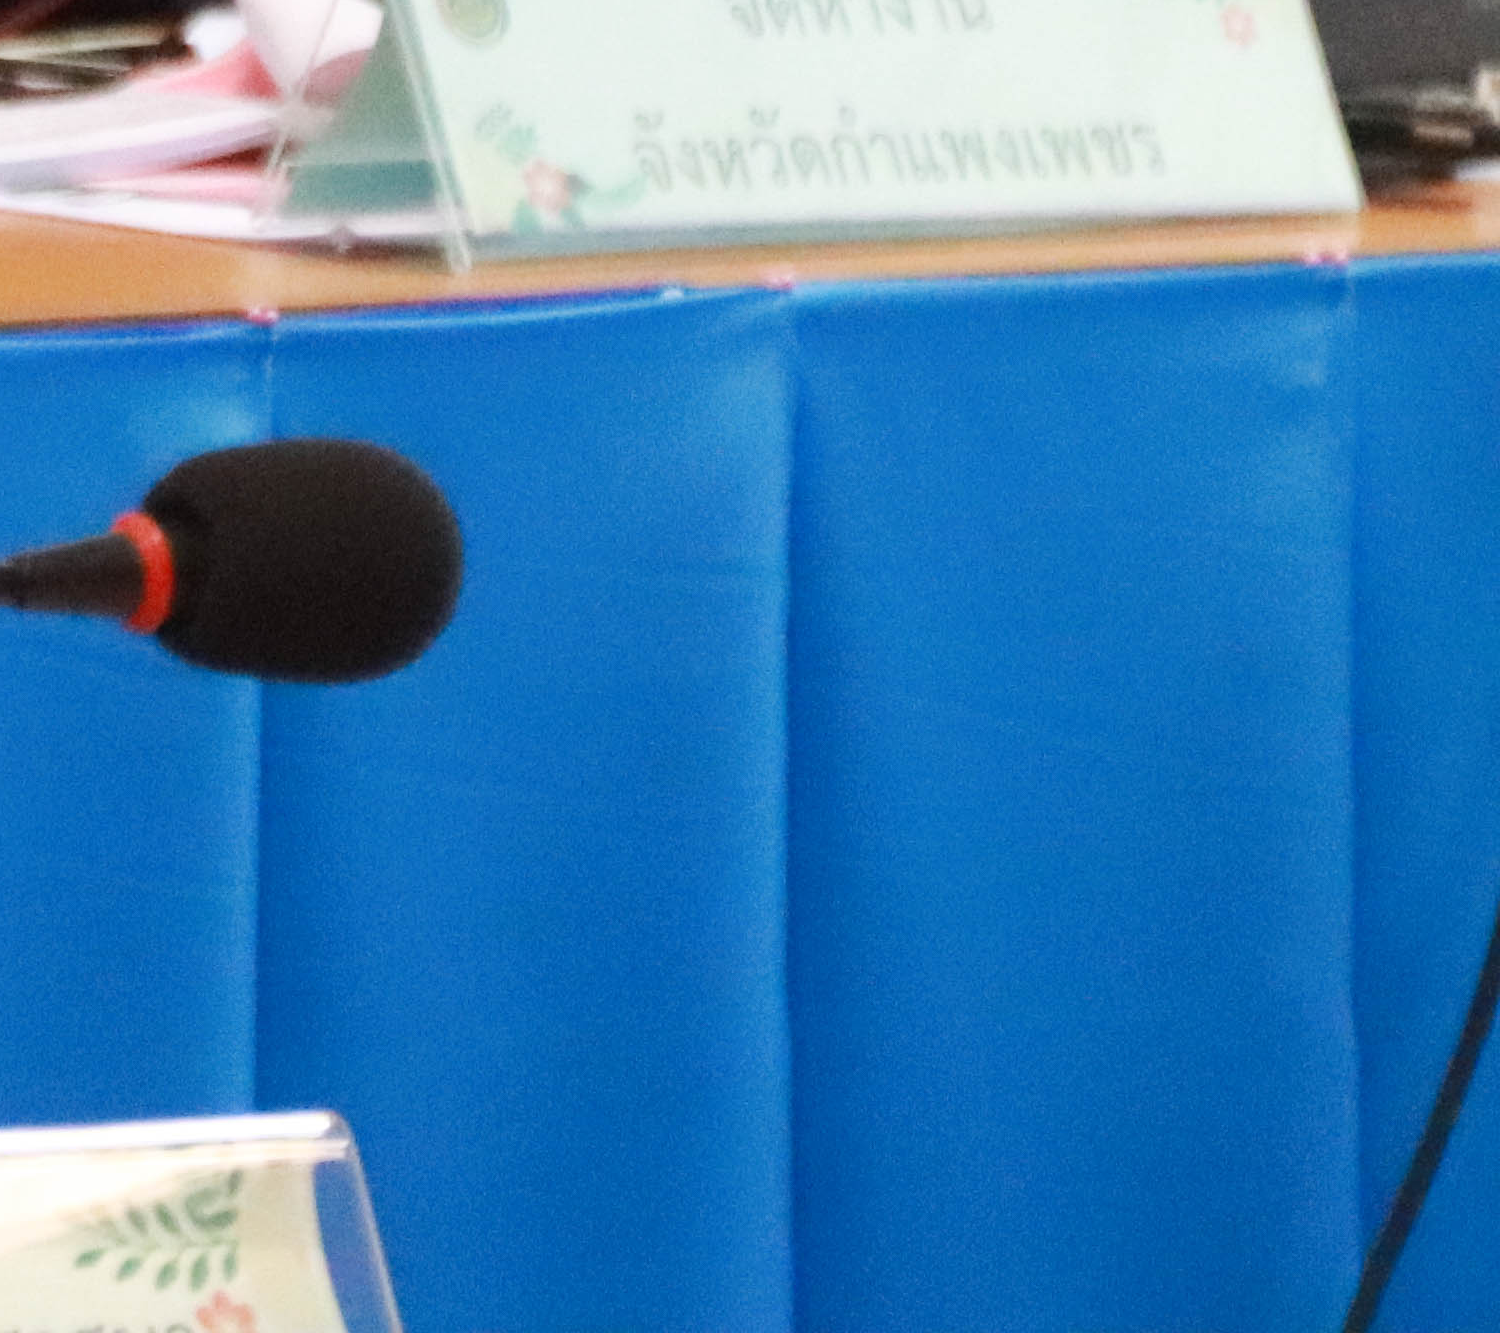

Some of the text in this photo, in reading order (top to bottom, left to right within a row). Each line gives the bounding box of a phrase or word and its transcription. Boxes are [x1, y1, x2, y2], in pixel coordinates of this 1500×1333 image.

[633, 104, 1166, 191] จังหวัดกำแพงเพชร
